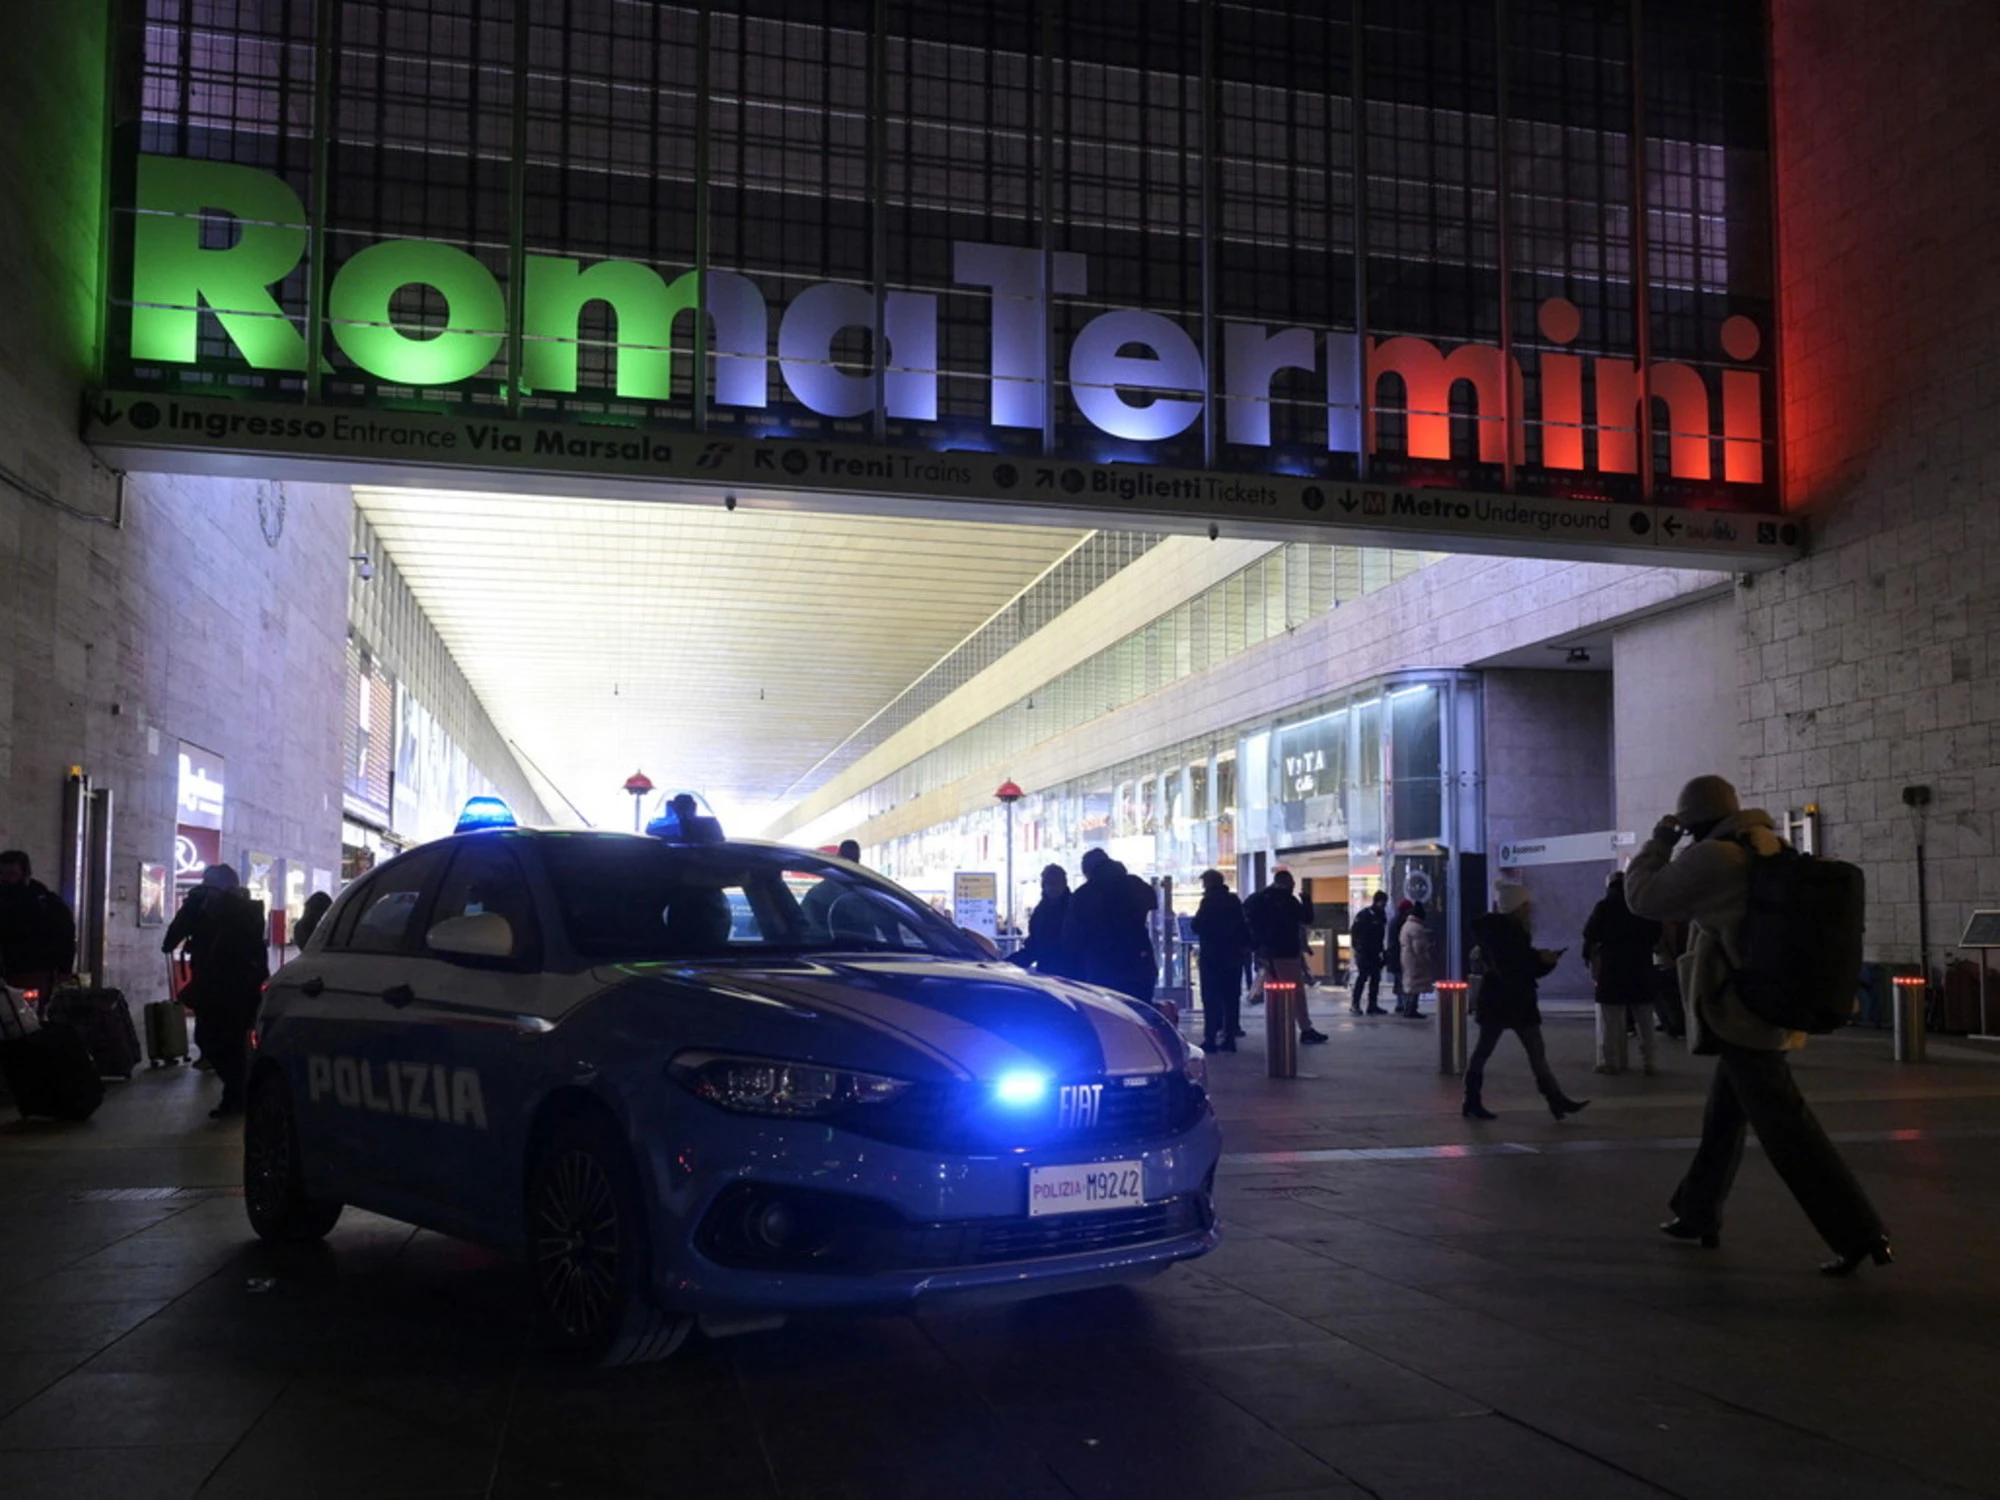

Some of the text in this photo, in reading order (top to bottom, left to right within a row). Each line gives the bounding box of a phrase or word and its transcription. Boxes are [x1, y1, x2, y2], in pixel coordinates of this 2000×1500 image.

[169, 402, 671, 463] Ingresso Entrance Via Marsala
[816, 449, 971, 484] Treni Trains
[1092, 469, 1278, 507] Biglietti Tickets
[1392, 492, 1470, 519] Metro
[1475, 497, 1611, 532] Underground
[307, 1054, 489, 1131] POLIZIA
[1058, 1084, 1104, 1129] FIAT
[1033, 1170, 1139, 1201] POLIZIA M9242
